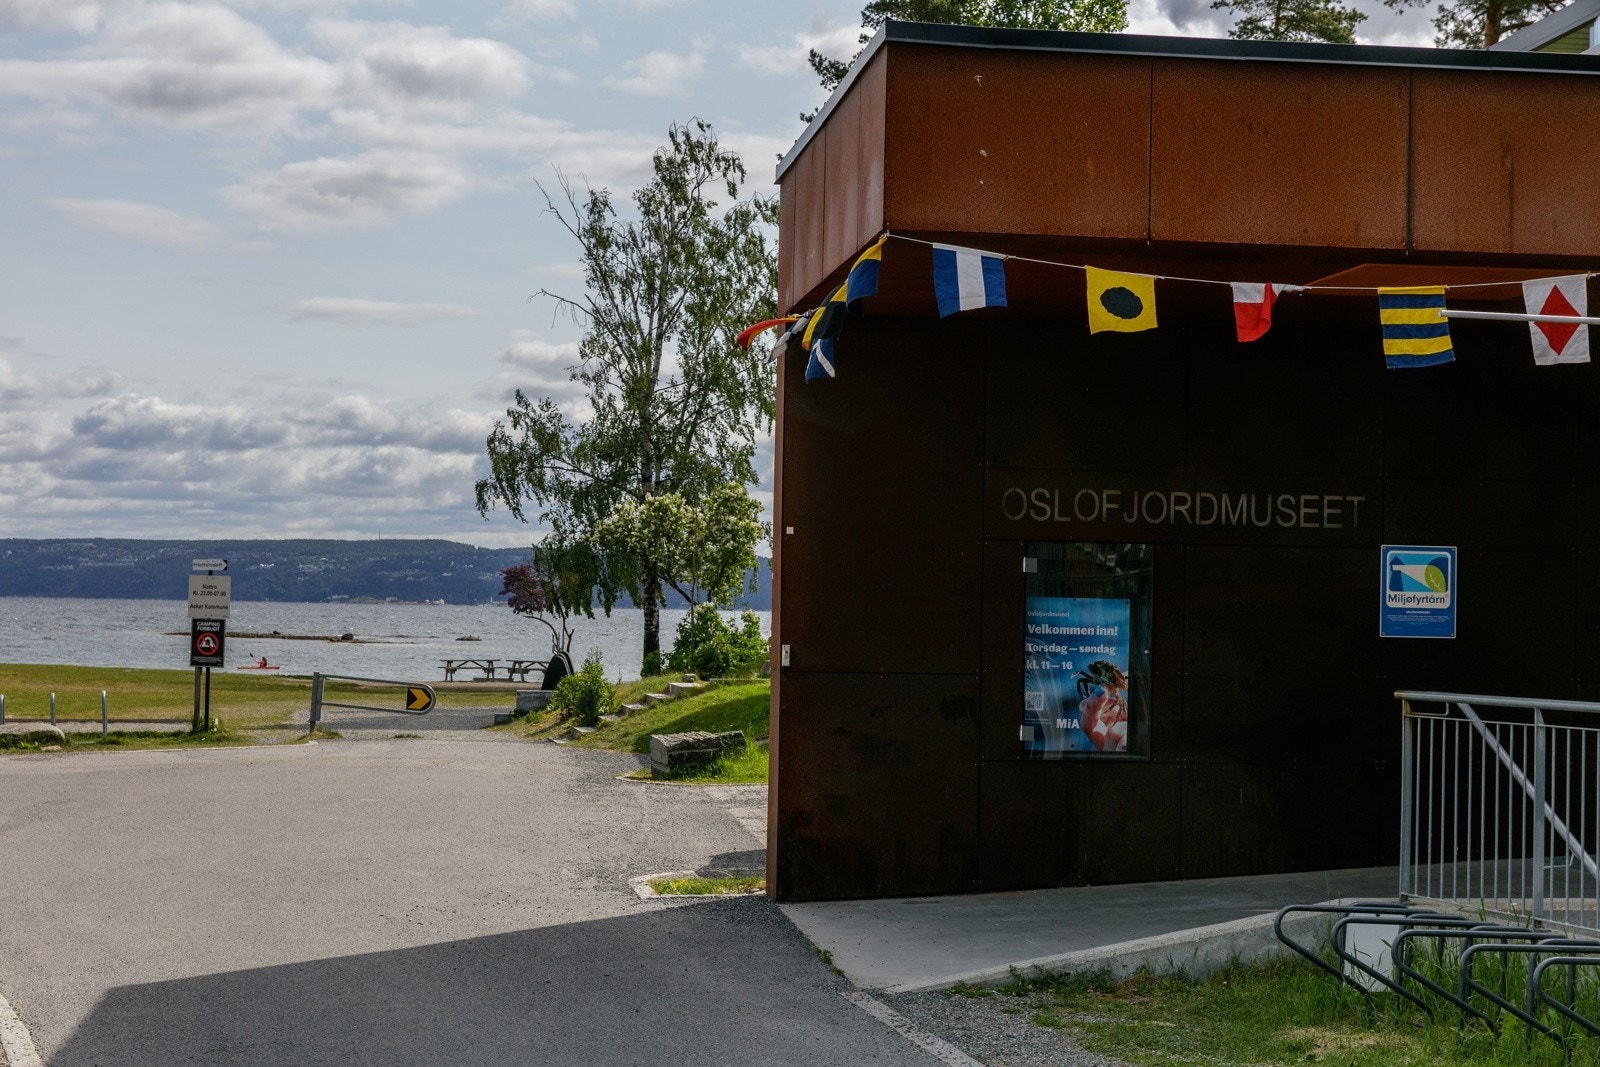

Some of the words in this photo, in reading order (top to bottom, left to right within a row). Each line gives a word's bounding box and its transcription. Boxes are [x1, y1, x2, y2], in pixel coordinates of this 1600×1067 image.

[1001, 487, 1366, 529] OSLOFJORDMUSEET
[1388, 593, 1446, 606] Miljøfyrtårn
[1027, 624, 1095, 636] Velkommen
[1096, 625, 1118, 636] inn!
[1027, 643, 1068, 656] Torsdag
[1079, 644, 1116, 657] søndag
[1026, 660, 1039, 670] kl.
[1061, 661, 1073, 670] 16
[1056, 719, 1080, 729] MiA
